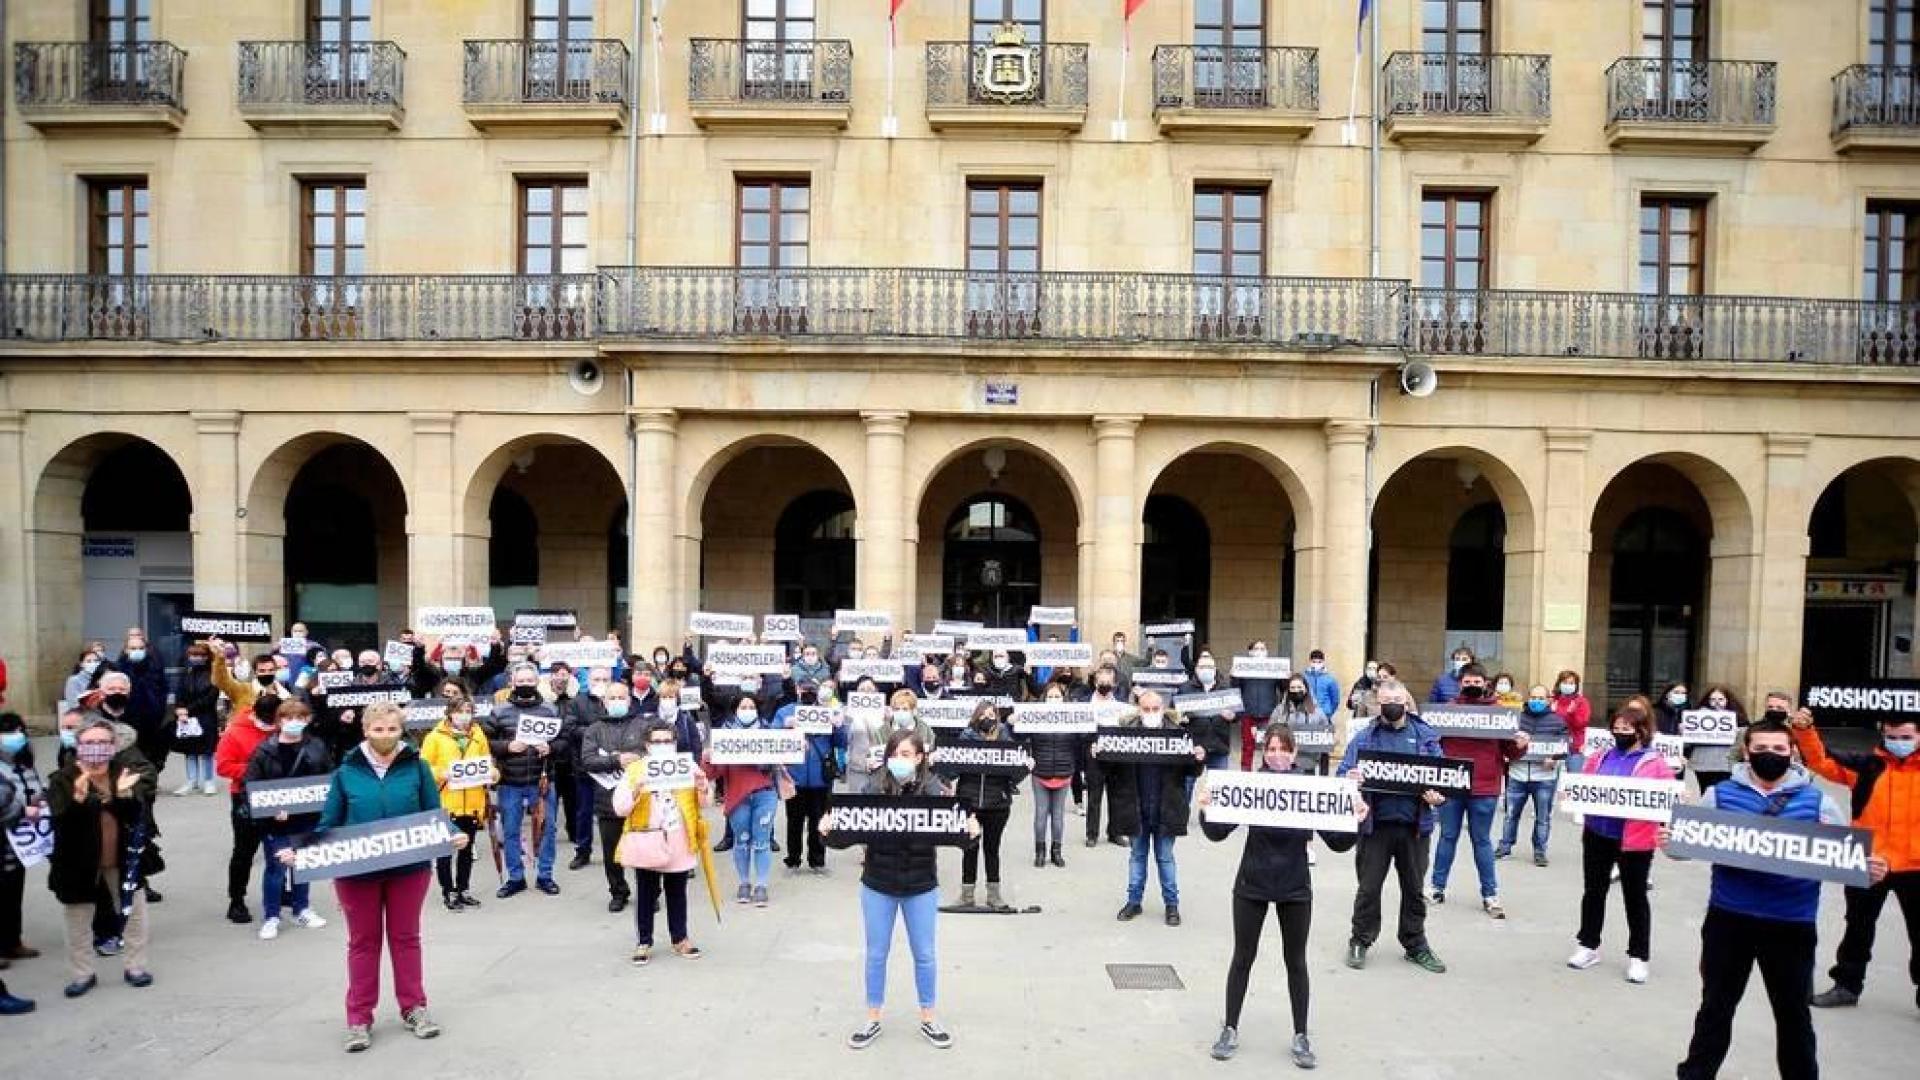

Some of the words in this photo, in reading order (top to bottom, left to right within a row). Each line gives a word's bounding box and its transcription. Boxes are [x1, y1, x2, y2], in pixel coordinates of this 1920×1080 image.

[182, 617, 271, 635] #SOSHOSTELERÍA
[768, 618, 796, 631] SOS
[851, 696, 882, 709] SOS
[797, 708, 830, 724] SOS
[1421, 711, 1518, 730] #SOSHOSTELERÍA
[1684, 714, 1733, 732] SOS
[521, 718, 557, 736] SOS
[1097, 732, 1194, 755] #SOSHOSTELERÍA
[450, 758, 490, 779] SOS
[647, 758, 691, 777] SOS
[1358, 759, 1471, 791] #SOSHOSTELERÍA
[1209, 784, 1355, 816] #SOSHOSTELERÍA
[1563, 784, 1680, 811] #SOSHOSTELERÍA
[831, 802, 969, 832] #SOSHOSTELERÍA
[296, 817, 450, 870] #SOSHOSTELERÍA
[1671, 817, 1867, 872] #SOSHOSTELERÍA
